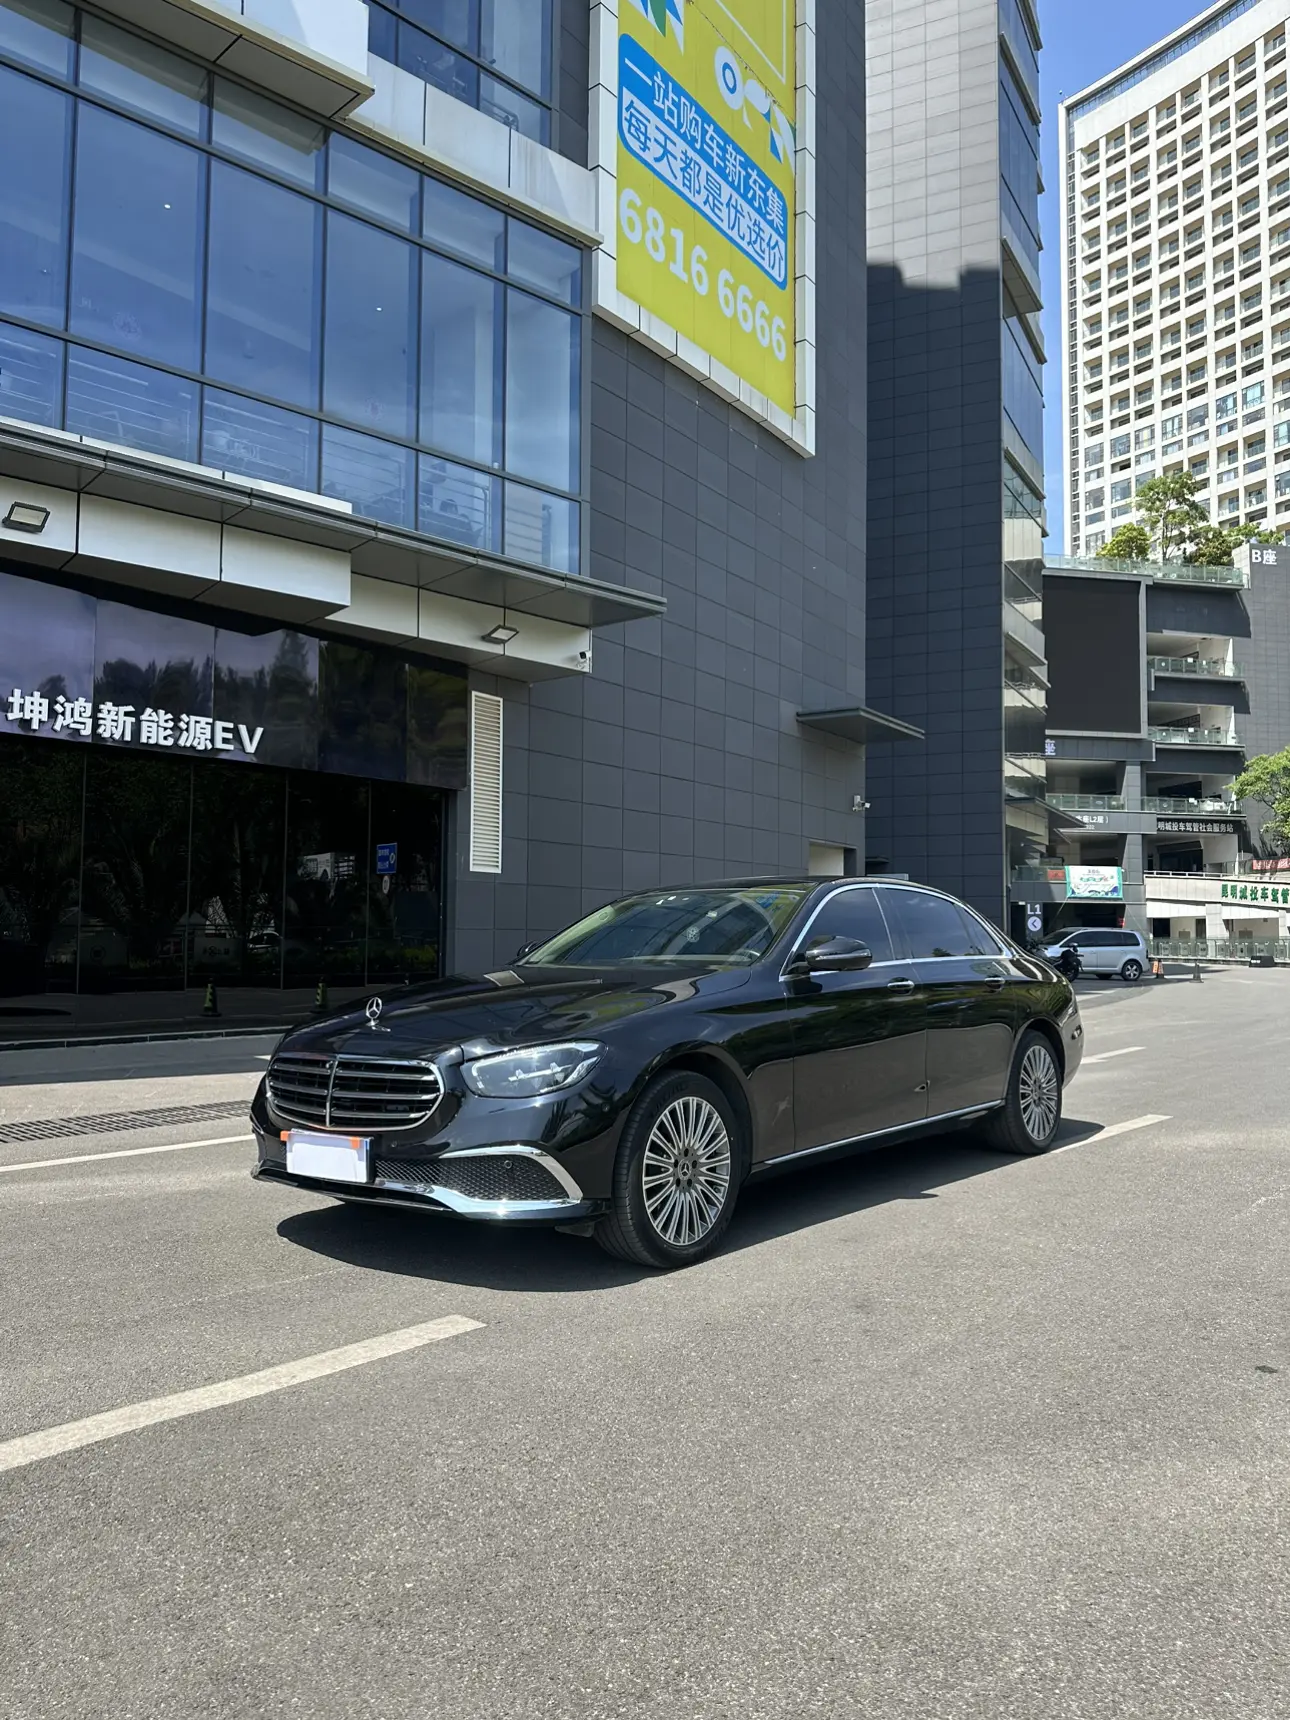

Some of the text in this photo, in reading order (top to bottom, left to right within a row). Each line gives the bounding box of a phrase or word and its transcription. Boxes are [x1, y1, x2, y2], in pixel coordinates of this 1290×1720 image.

[624, 57, 784, 236] 一站购车新东集
[624, 99, 784, 279] 每天都是优选价
[619, 187, 787, 362] 6816 6666
[1251, 549, 1278, 565] B座
[6, 688, 264, 754] 坤鸿新能源EV
[1027, 903, 1042, 915] L1
